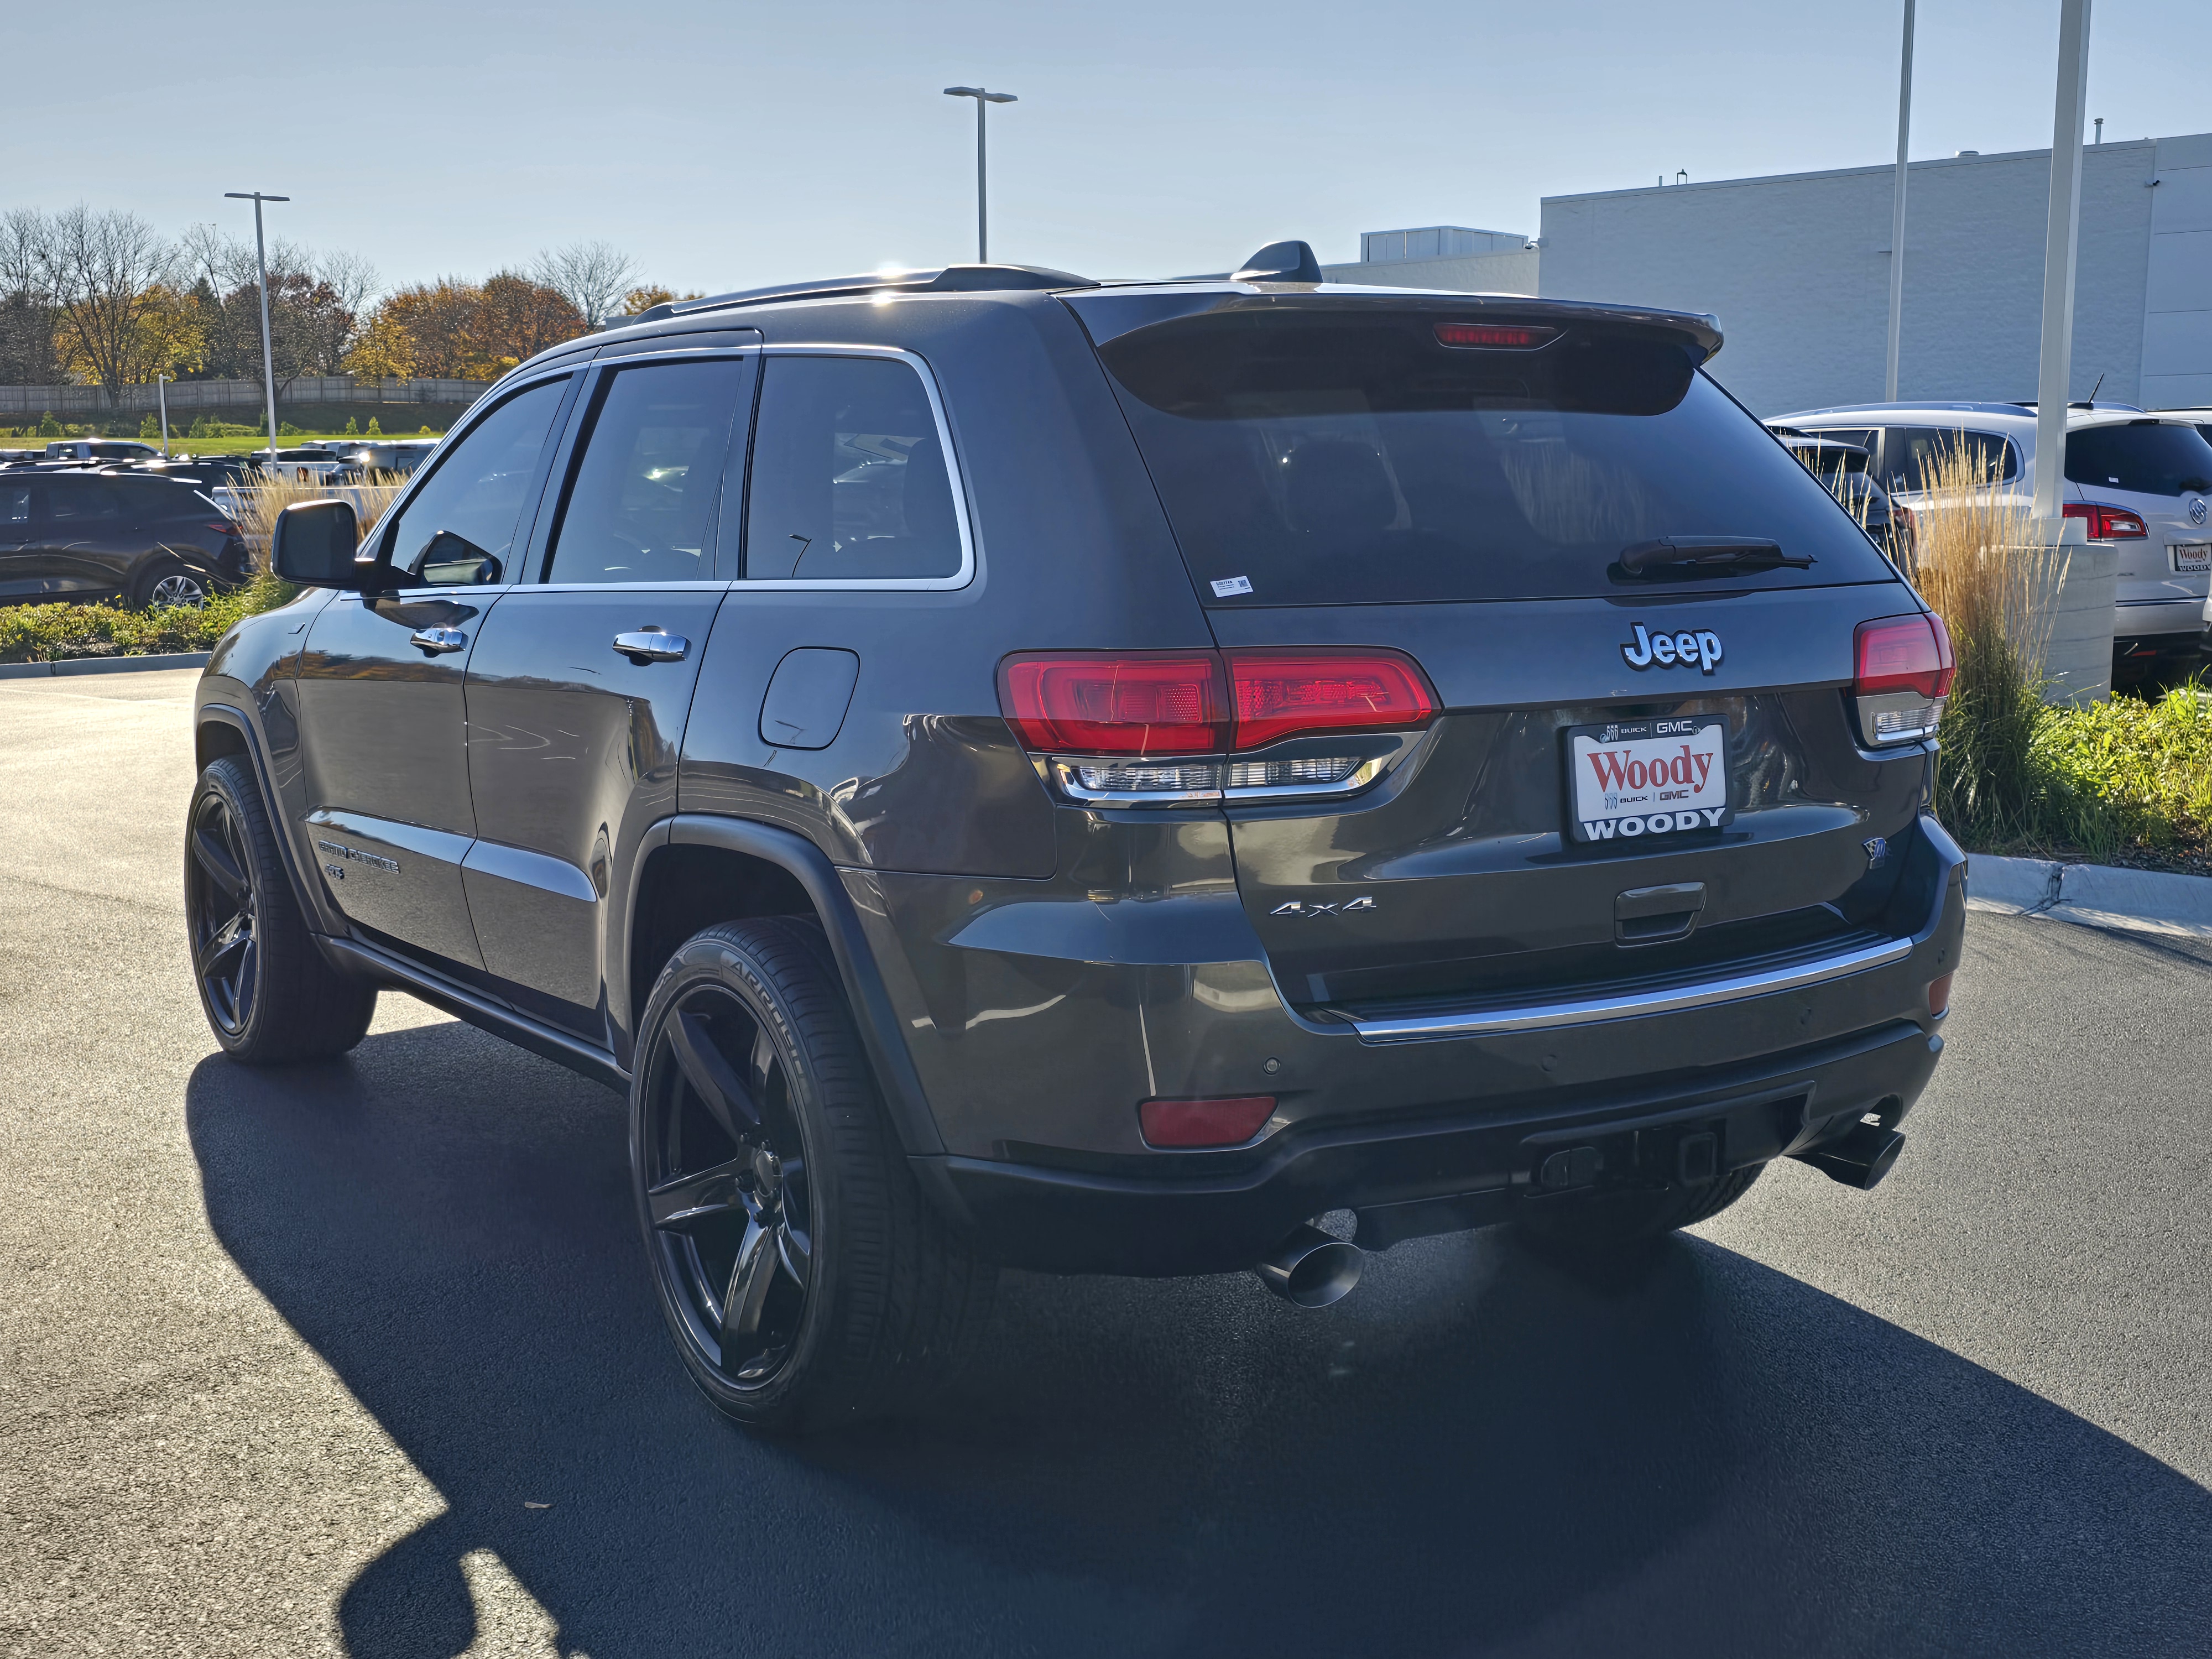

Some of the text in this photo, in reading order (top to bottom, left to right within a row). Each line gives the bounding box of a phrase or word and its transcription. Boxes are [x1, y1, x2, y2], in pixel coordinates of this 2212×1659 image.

[2179, 548, 2208, 561] Woody
[1620, 622, 1723, 676] Jeep
[1657, 721, 1692, 733] GMC
[1587, 745, 1714, 793] Woody
[1660, 790, 1689, 801] GMC
[1583, 808, 1725, 841] WOODY
[319, 840, 400, 874] GRAND CHEROKEE
